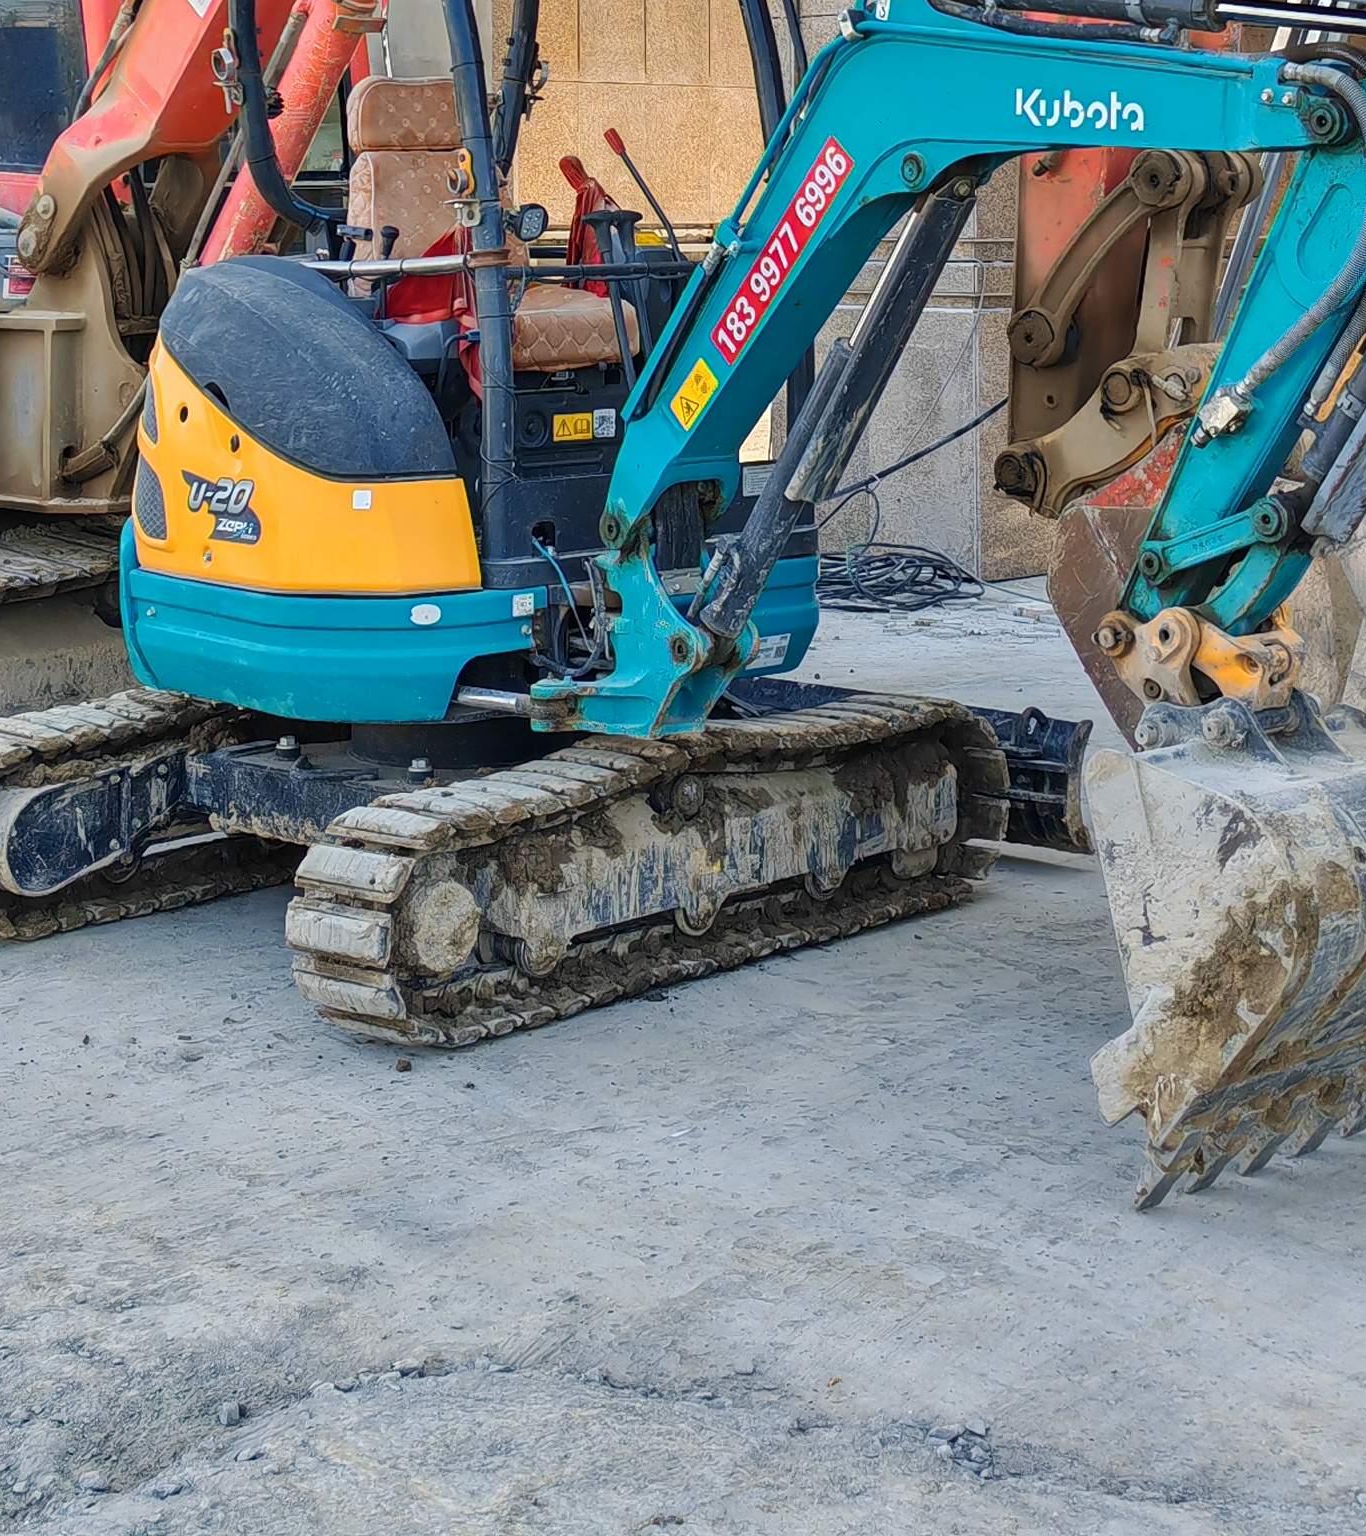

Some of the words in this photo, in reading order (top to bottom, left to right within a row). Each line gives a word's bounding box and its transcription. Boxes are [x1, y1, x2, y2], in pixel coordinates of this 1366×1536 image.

[1014, 87, 1145, 132] Kubota
[717, 295, 756, 354] 183
[750, 221, 799, 302] 9977
[794, 146, 847, 229] 6996
[188, 476, 255, 514] U-20
